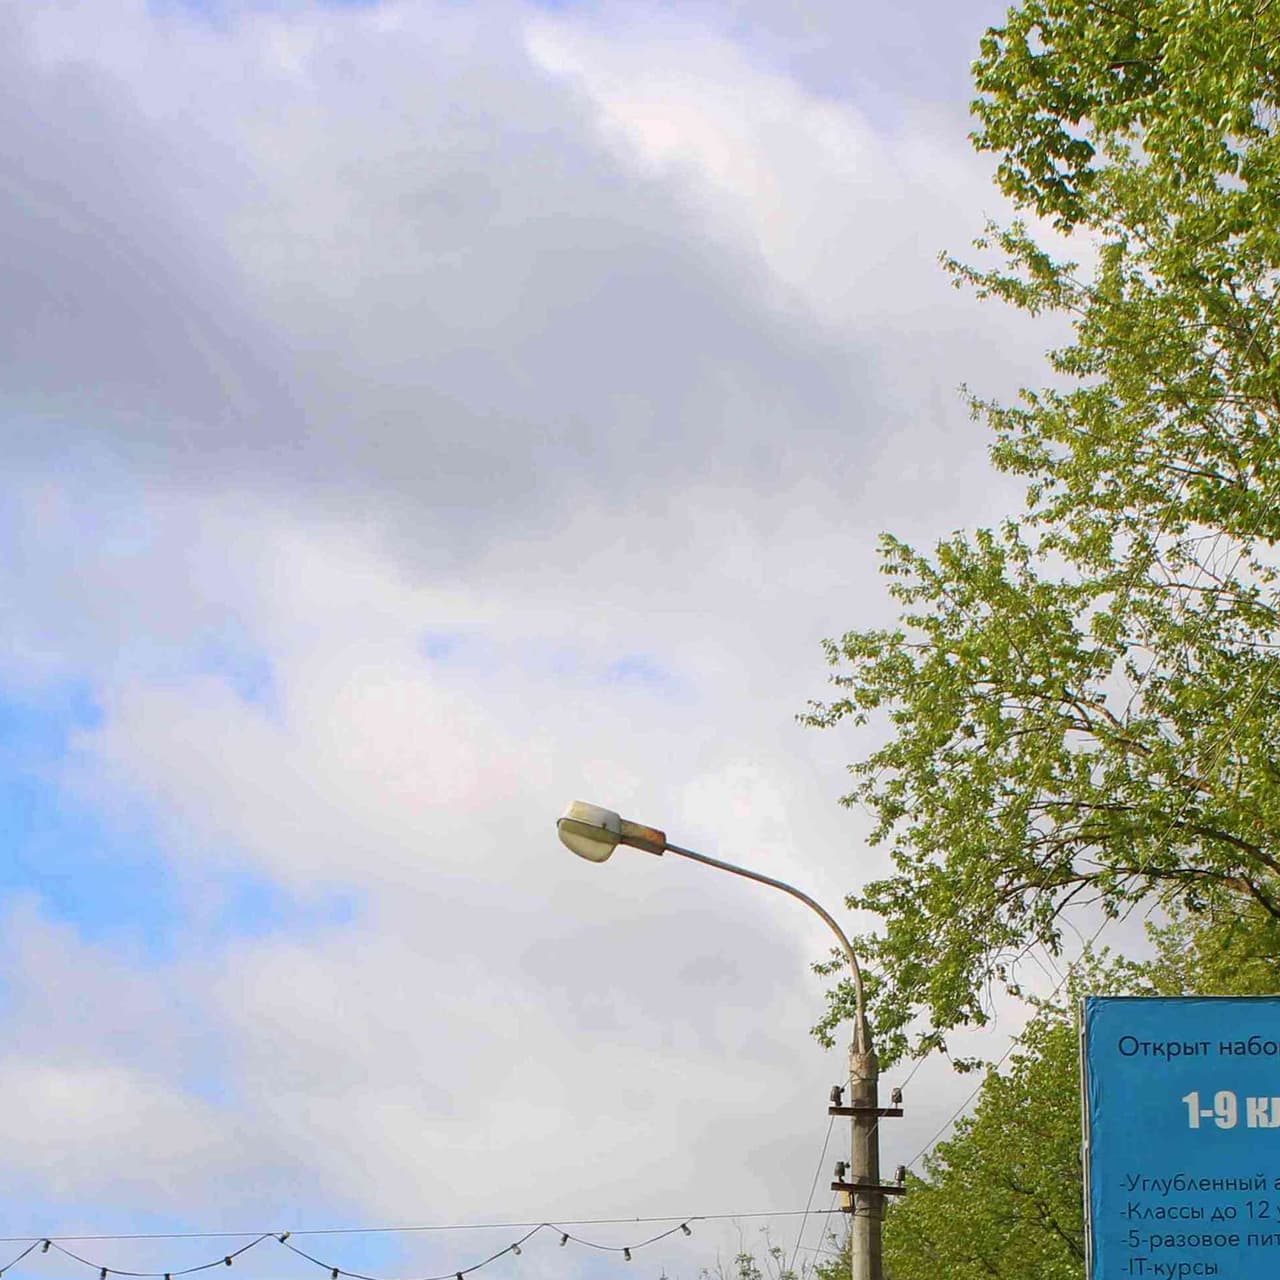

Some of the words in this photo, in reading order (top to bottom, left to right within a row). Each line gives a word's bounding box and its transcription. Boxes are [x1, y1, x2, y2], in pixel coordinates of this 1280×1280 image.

[1119, 1035, 1210, 1061] Открыт
[1182, 1091, 1237, 1129] 1-9
[1119, 1173, 1267, 1196] -Углубленный
[1120, 1204, 1205, 1220] -Классы
[1210, 1207, 1237, 1222] до
[1246, 1201, 1271, 1219] 12
[1121, 1230, 1240, 1252] -5-разовое
